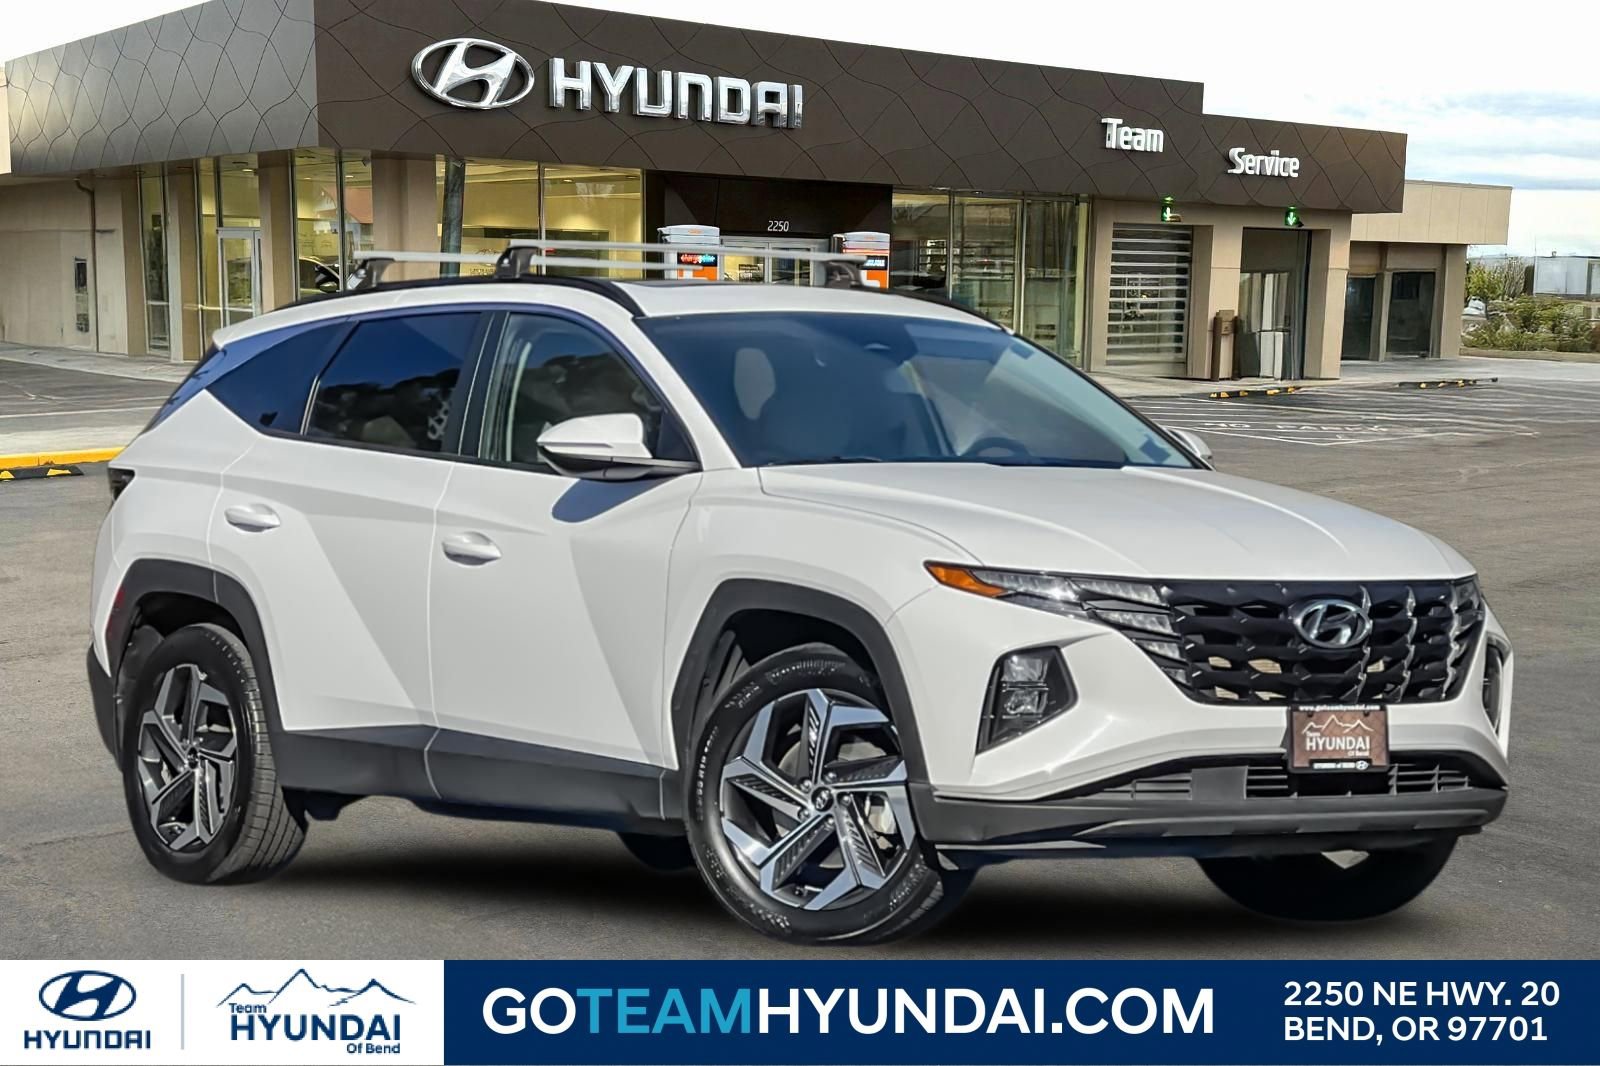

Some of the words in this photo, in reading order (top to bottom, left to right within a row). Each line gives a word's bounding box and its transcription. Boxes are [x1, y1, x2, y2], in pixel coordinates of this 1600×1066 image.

[549, 57, 803, 128] HYUNDAI
[1101, 117, 1164, 153] Team
[1227, 147, 1300, 178] Service
[767, 221, 790, 232] 2250
[1306, 736, 1370, 751] HYUNDAI
